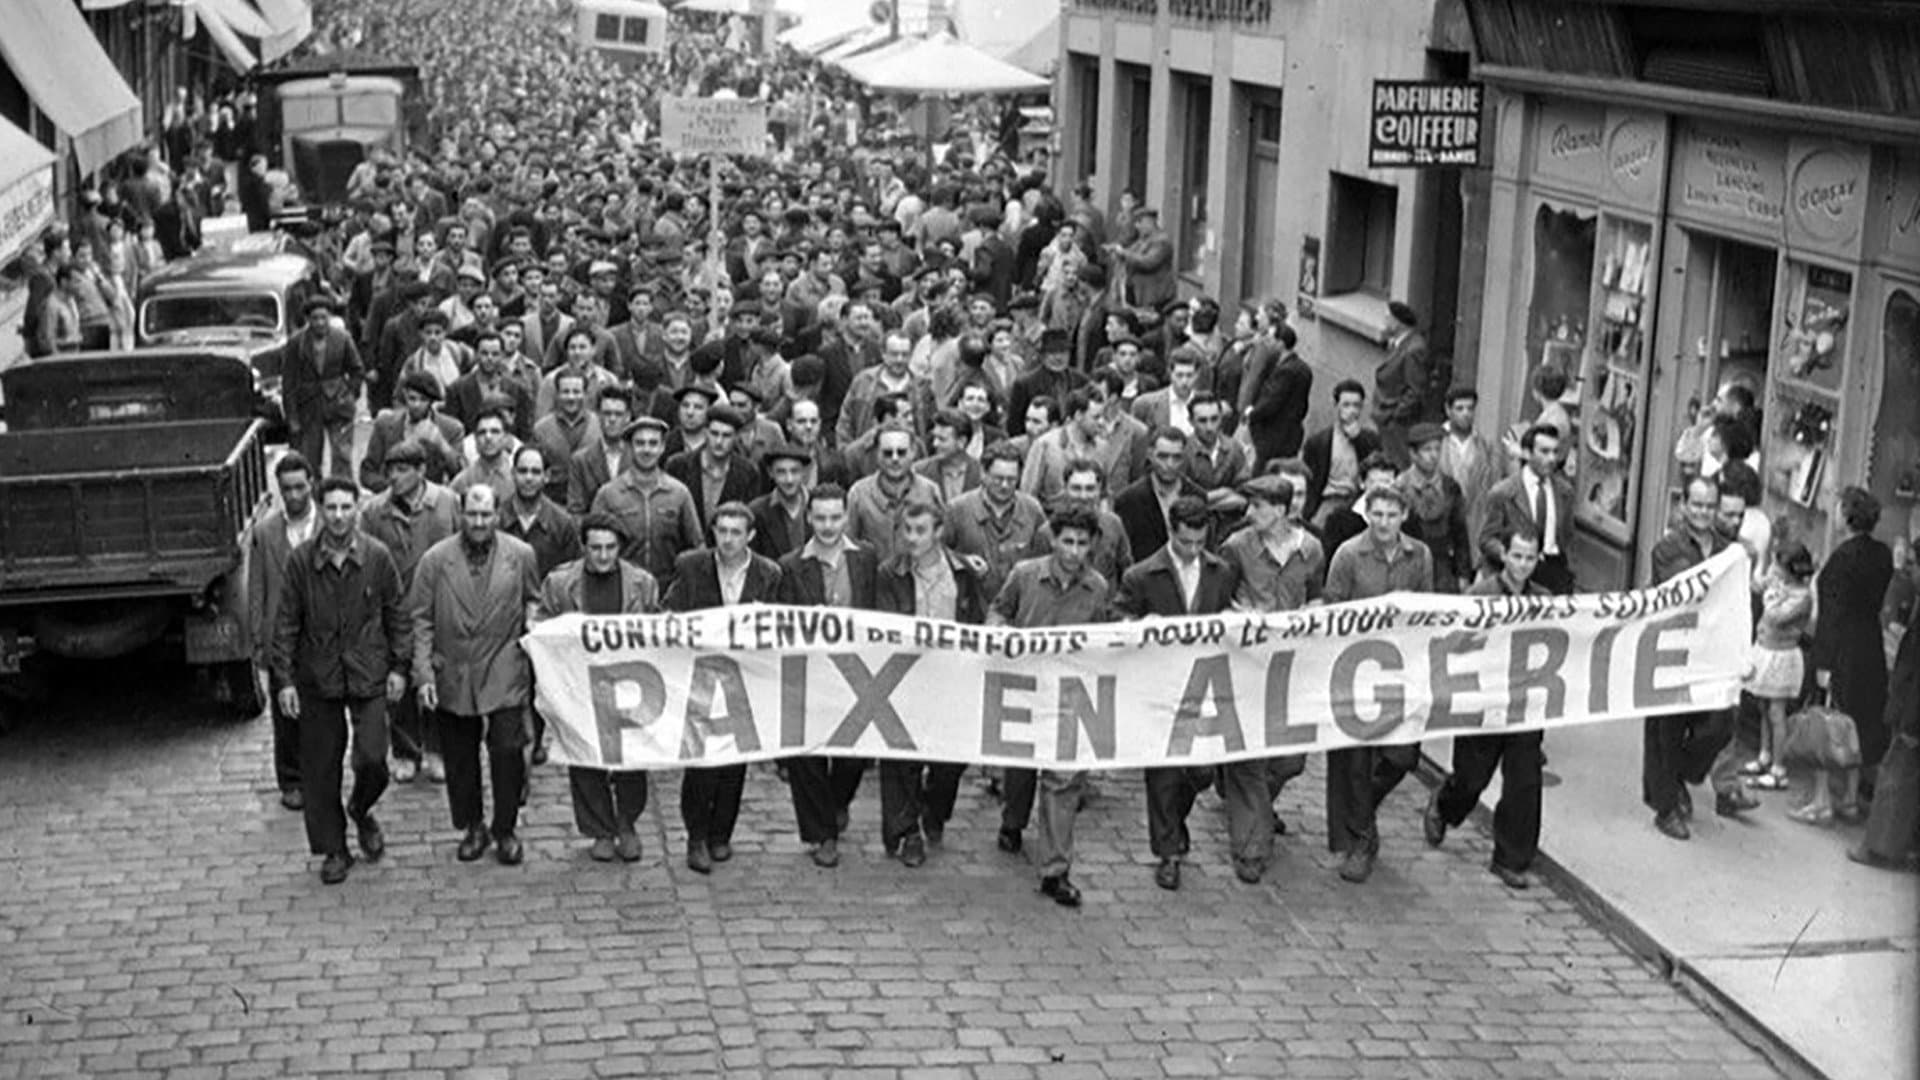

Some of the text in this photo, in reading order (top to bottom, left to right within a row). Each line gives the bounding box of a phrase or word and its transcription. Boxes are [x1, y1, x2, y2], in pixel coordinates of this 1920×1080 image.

[1375, 85, 1479, 112] PARFUMERIE
[1375, 114, 1478, 147] COIFFEUR
[581, 614, 703, 653] CONTRE
[728, 610, 854, 650] L'ENVOI
[867, 627, 901, 645] DE
[1407, 610, 1459, 627] DES
[587, 653, 923, 764] PAIX
[980, 670, 1117, 762] EN
